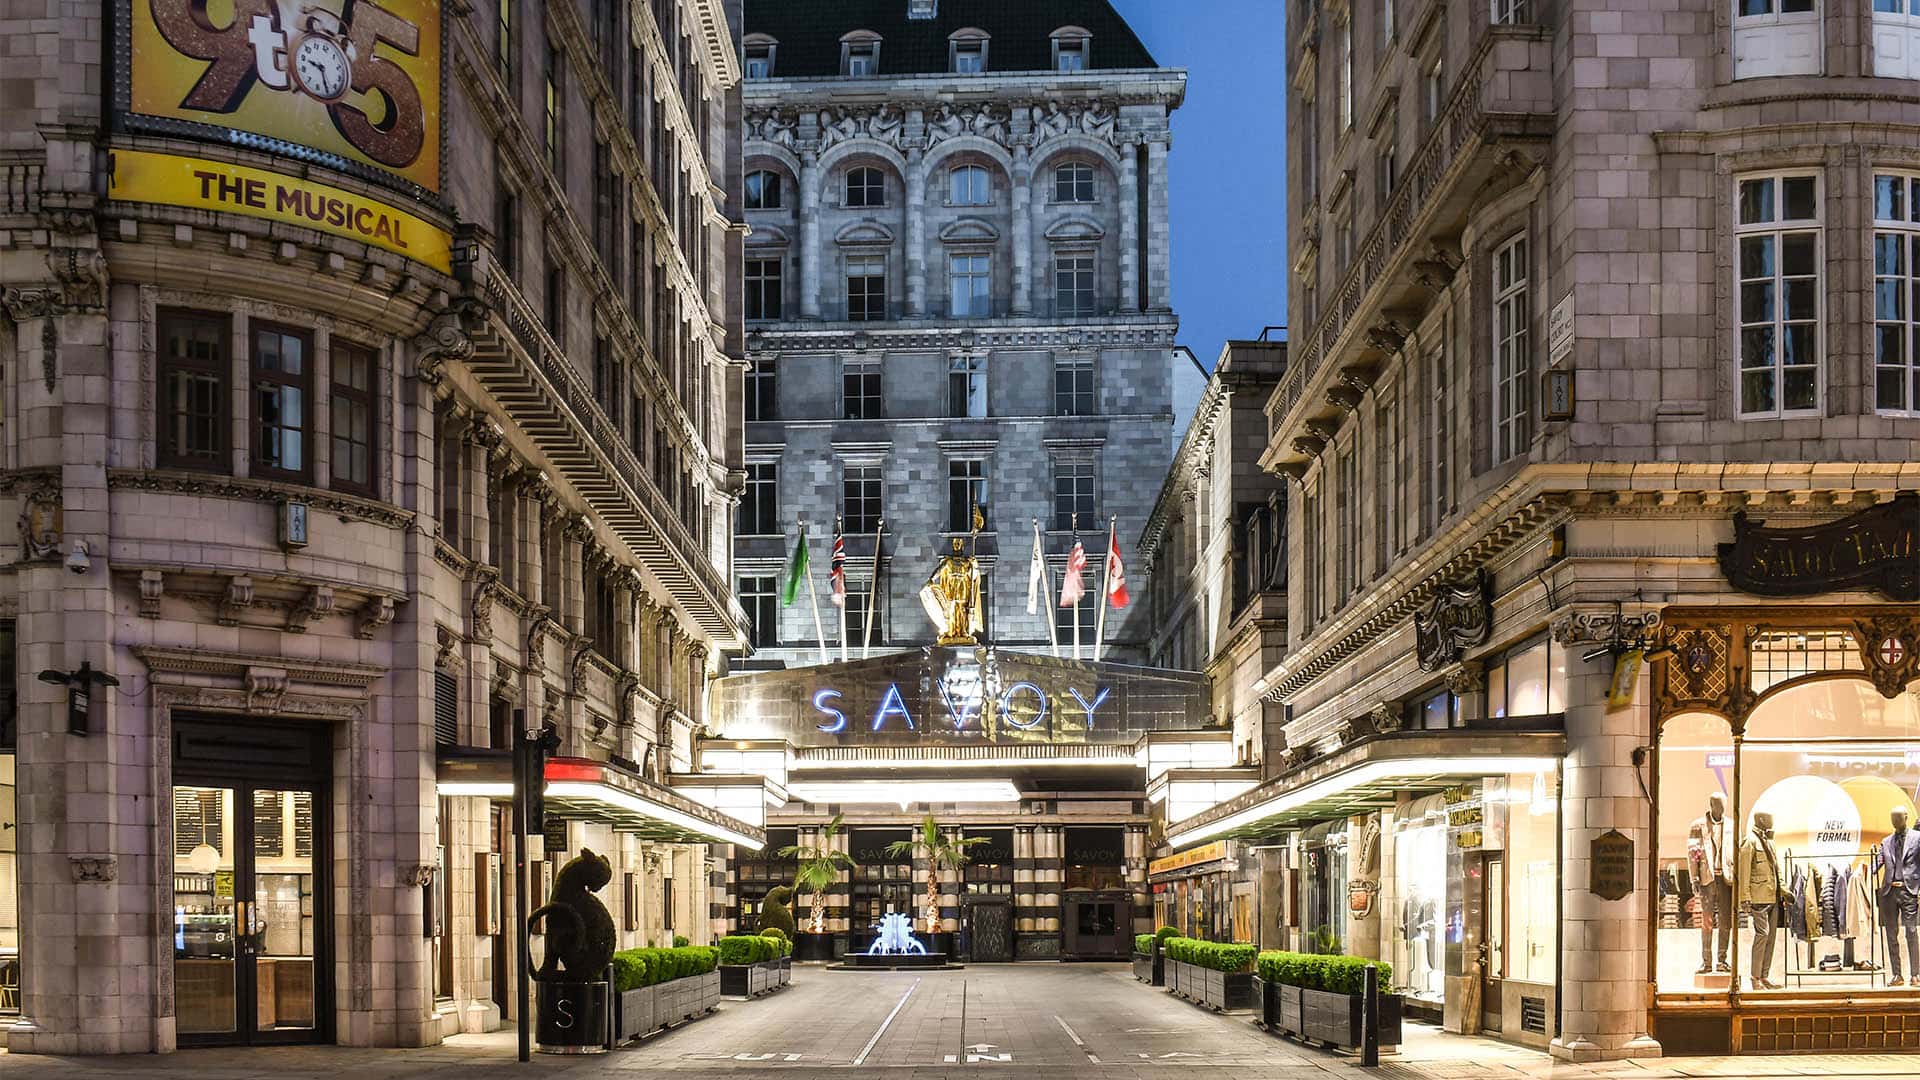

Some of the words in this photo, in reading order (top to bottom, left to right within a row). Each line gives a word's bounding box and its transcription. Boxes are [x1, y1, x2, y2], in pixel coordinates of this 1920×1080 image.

[150, 0, 280, 113] 9
[326, 0, 424, 168] 5
[194, 170, 266, 209] THE
[276, 185, 408, 249] MUSICAL
[293, 506, 301, 540] TAXI
[1751, 543, 1838, 577] SAVOY
[812, 679, 1111, 732] SAVOY
[1816, 832, 1852, 842] FORMAL
[1824, 820, 1846, 831] NEW
[556, 999, 574, 1029] S
[943, 1053, 1012, 1063] IN
